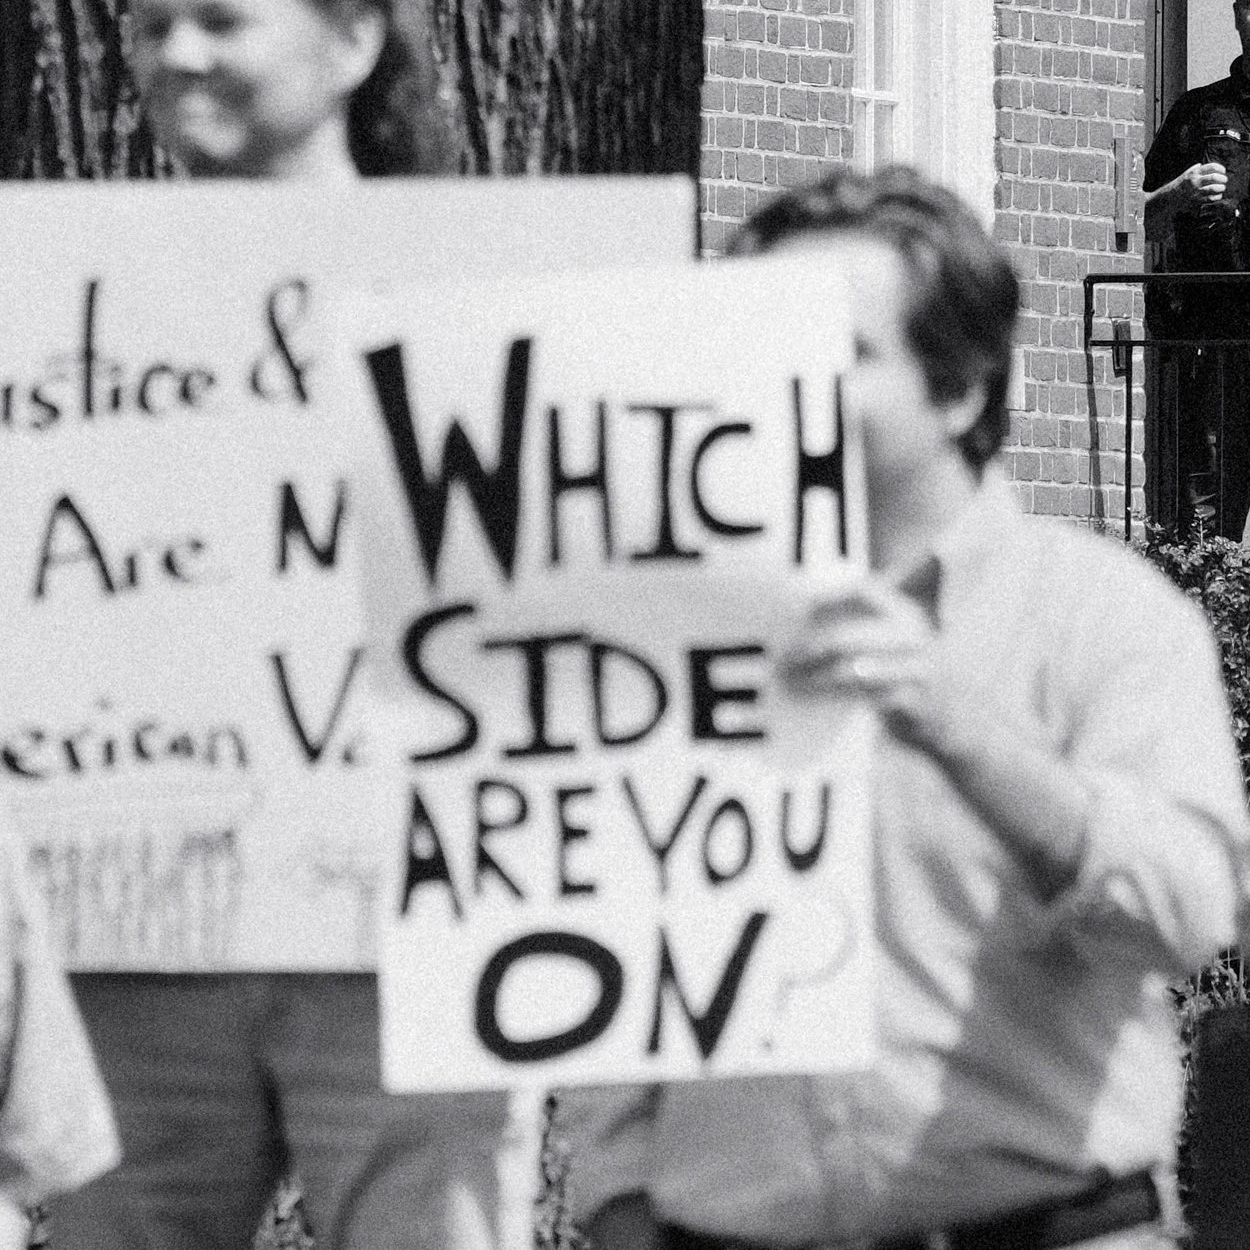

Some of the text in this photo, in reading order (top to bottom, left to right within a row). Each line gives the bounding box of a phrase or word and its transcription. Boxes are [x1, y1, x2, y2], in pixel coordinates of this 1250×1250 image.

[250, 278, 312, 406] &
[365, 335, 850, 588] WHICH
[34, 492, 206, 600] Are
[402, 602, 766, 764] SIDE
[401, 774, 832, 918] ARE YOU
